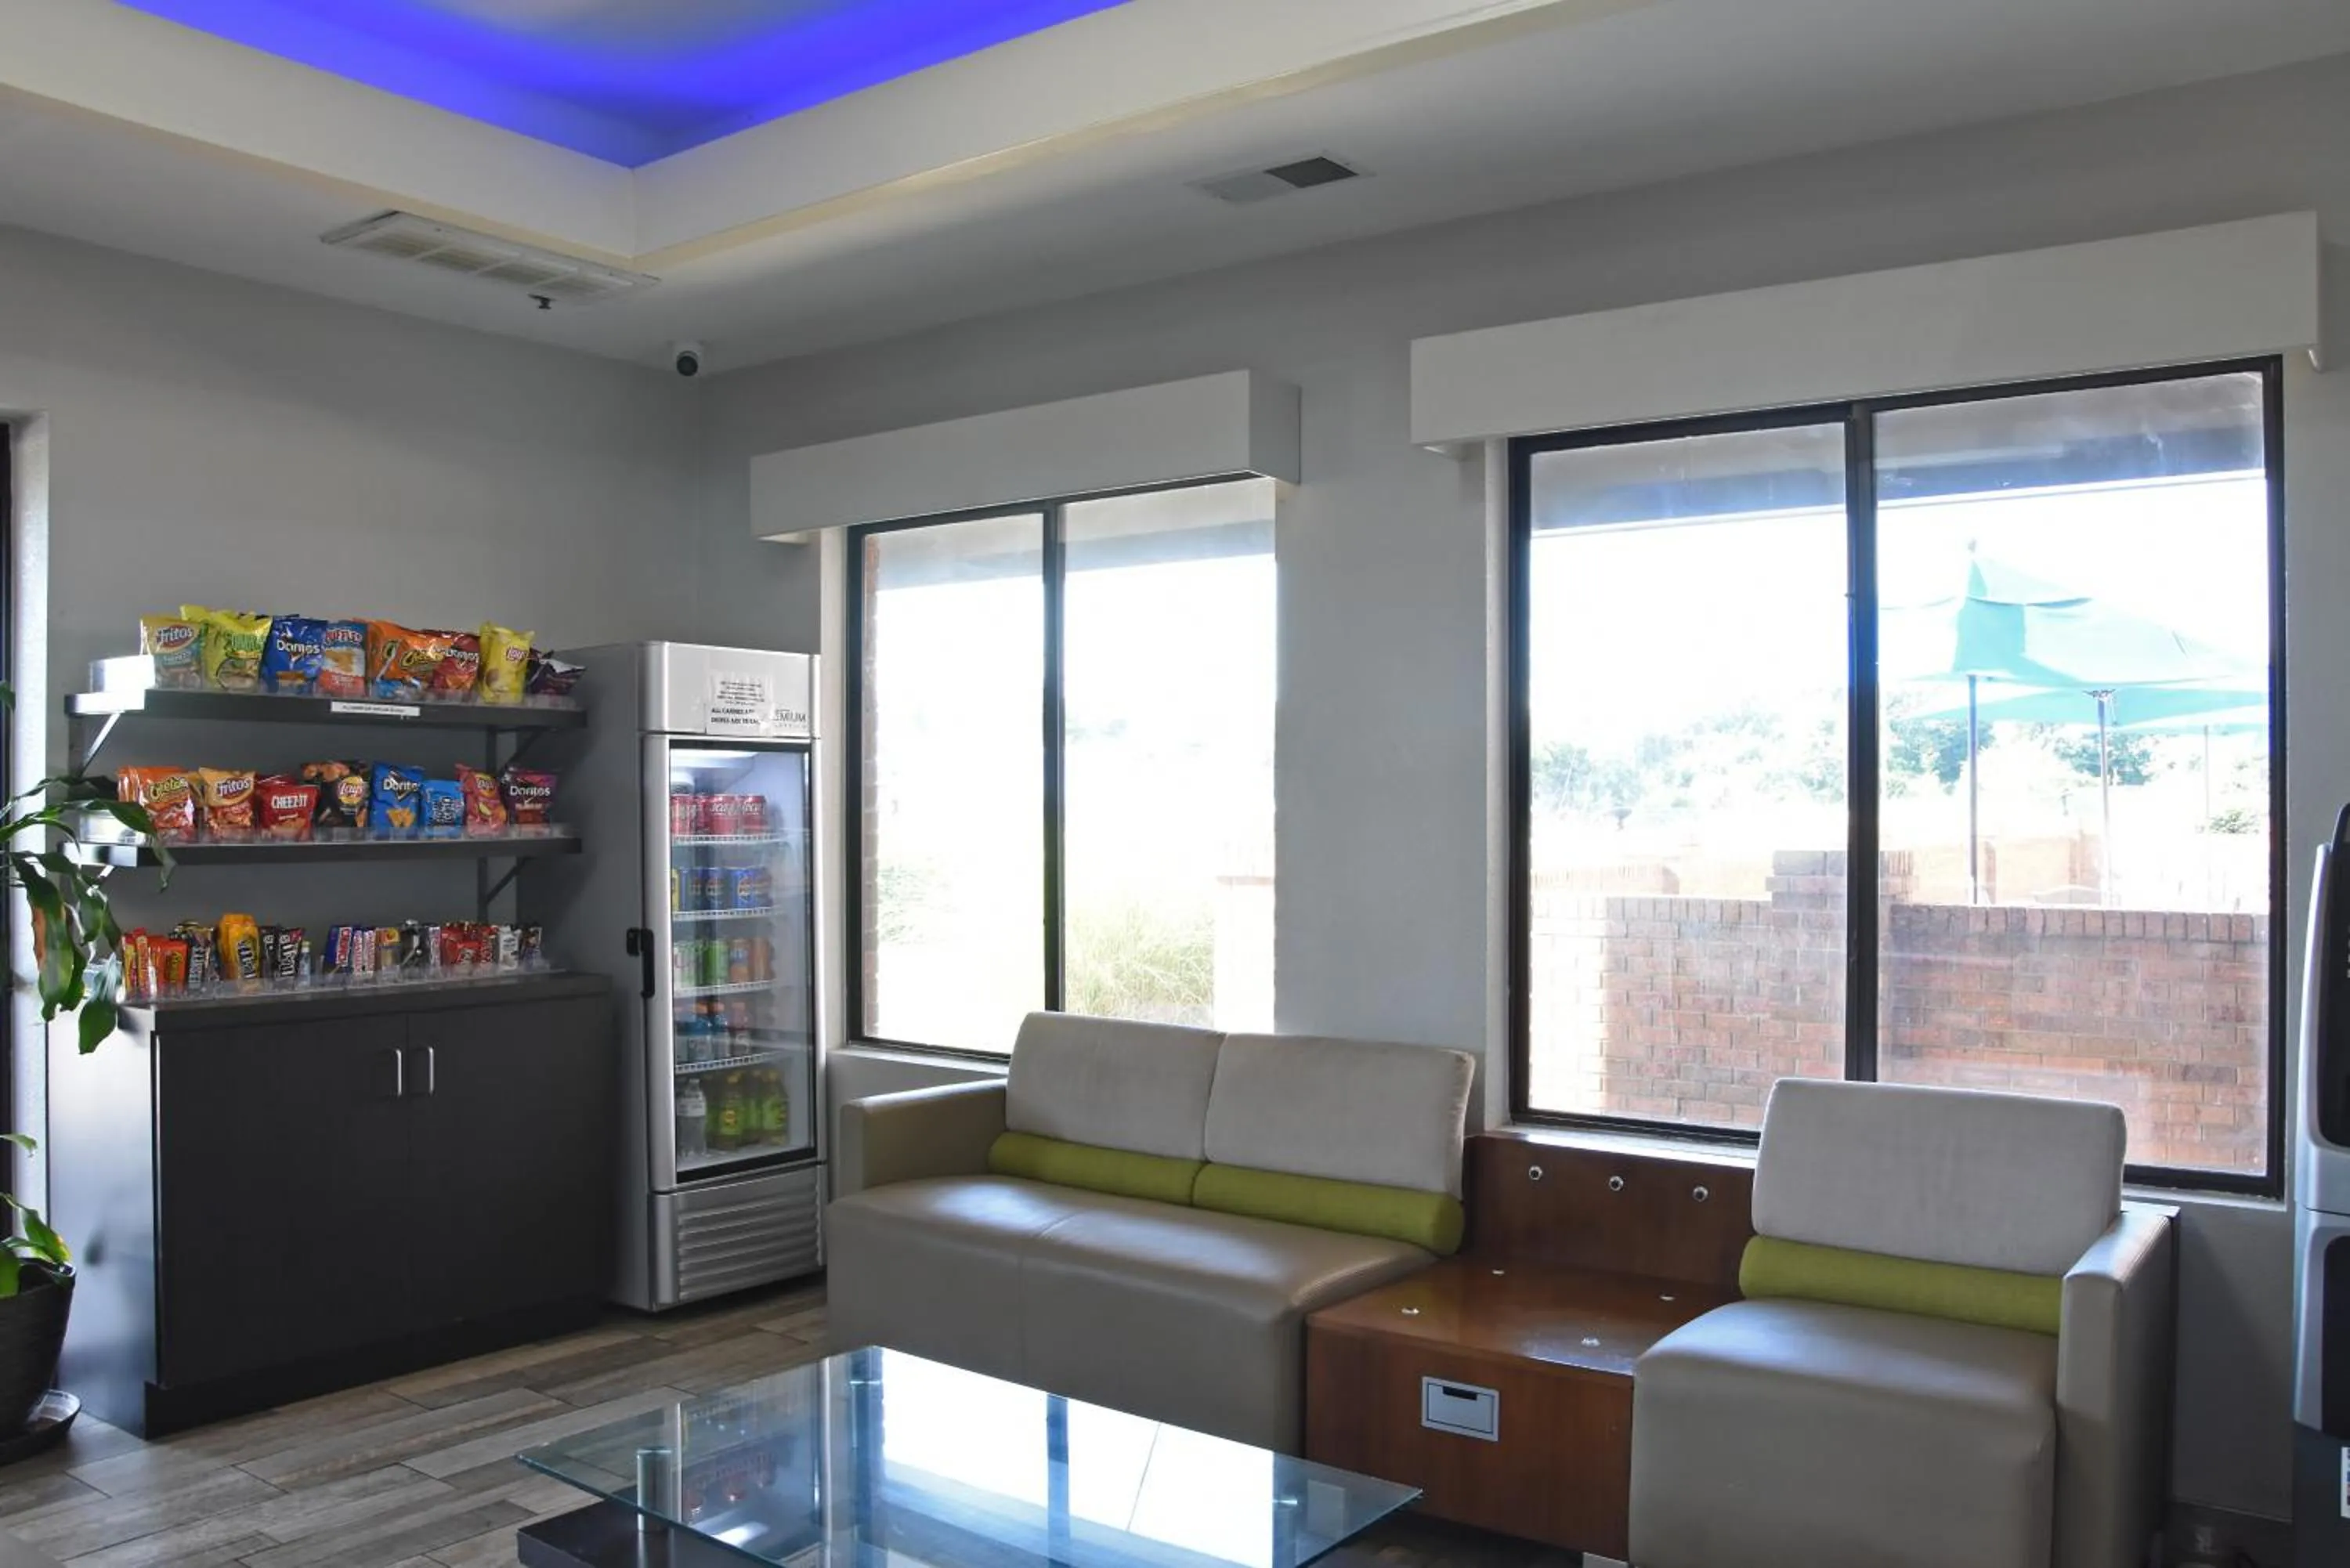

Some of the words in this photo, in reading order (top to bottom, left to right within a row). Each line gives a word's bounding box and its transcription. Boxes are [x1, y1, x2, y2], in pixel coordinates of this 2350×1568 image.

[157, 627, 193, 644] Fritos
[218, 778, 250, 797] Fritos
[510, 786, 550, 797] Doritos
